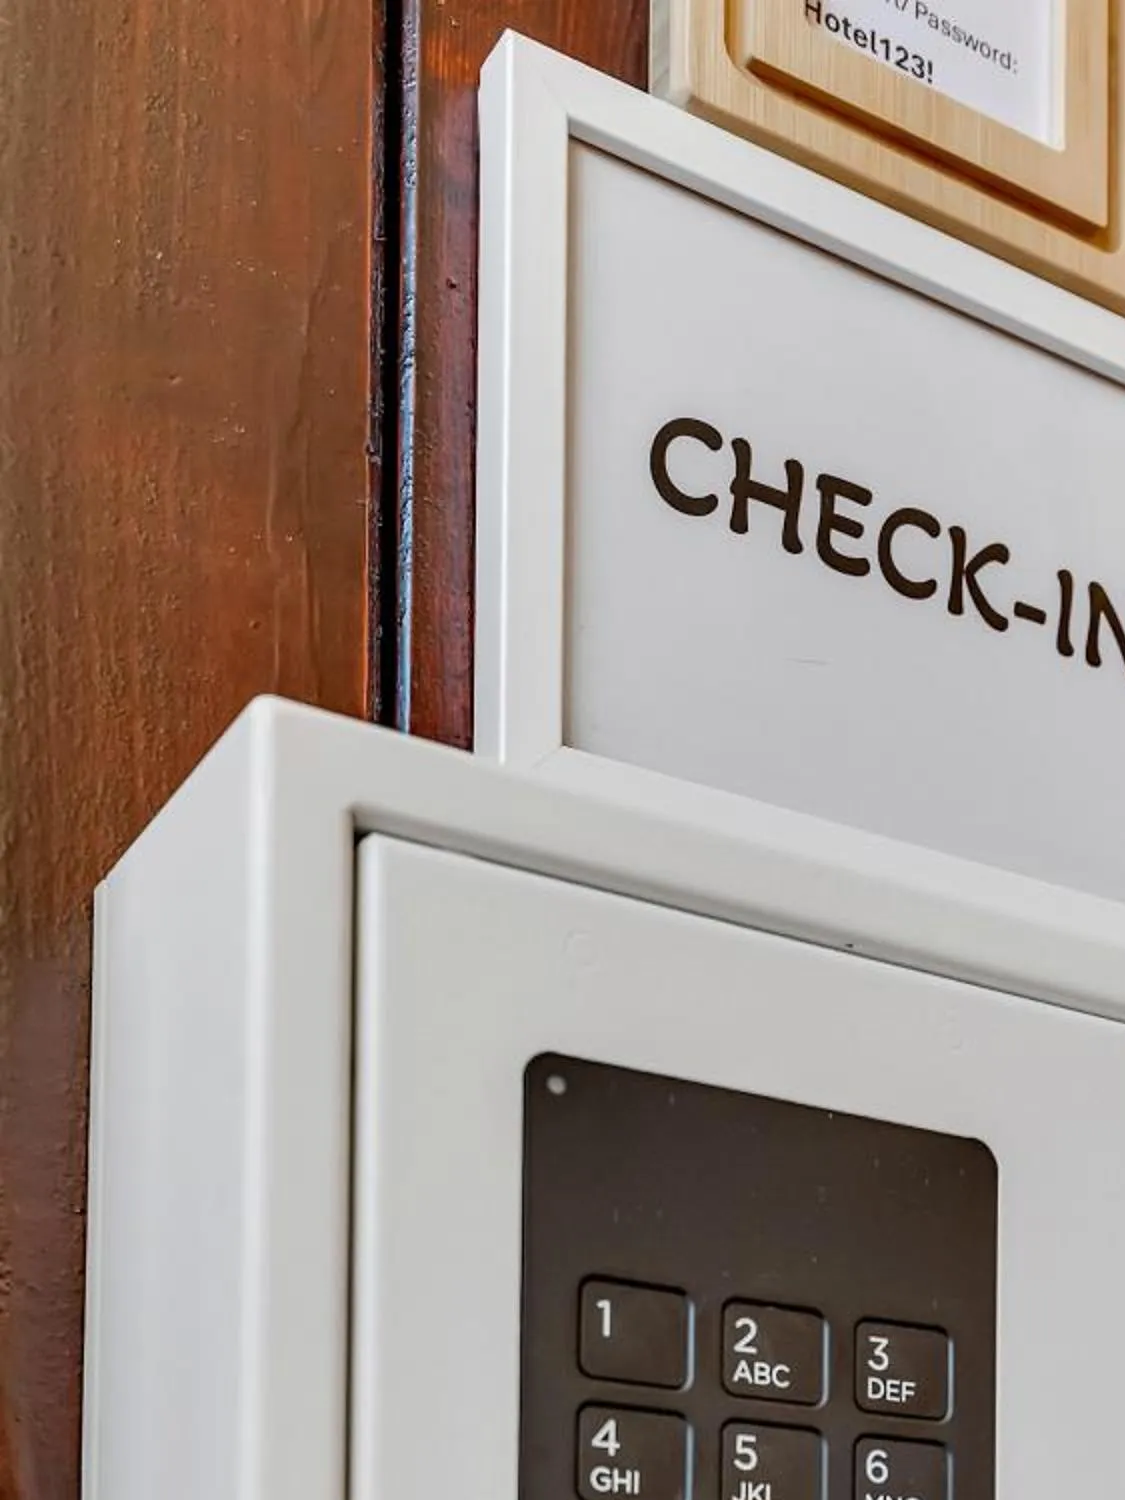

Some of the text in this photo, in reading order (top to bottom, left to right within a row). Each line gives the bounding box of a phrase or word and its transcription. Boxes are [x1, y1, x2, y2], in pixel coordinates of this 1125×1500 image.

[803, 0, 934, 84] Hotel123!
[914, 0, 1019, 74] Password:
[597, 1300, 611, 1337] 1
[733, 1317, 758, 1354] 2
[867, 1336, 889, 1371] 3
[732, 1359, 790, 1388] ABC
[867, 1376, 916, 1403] DEF
[591, 1419, 621, 1457] 4
[733, 1434, 758, 1471] 5
[589, 1466, 640, 1495] GHI
[865, 1449, 889, 1484] 6
